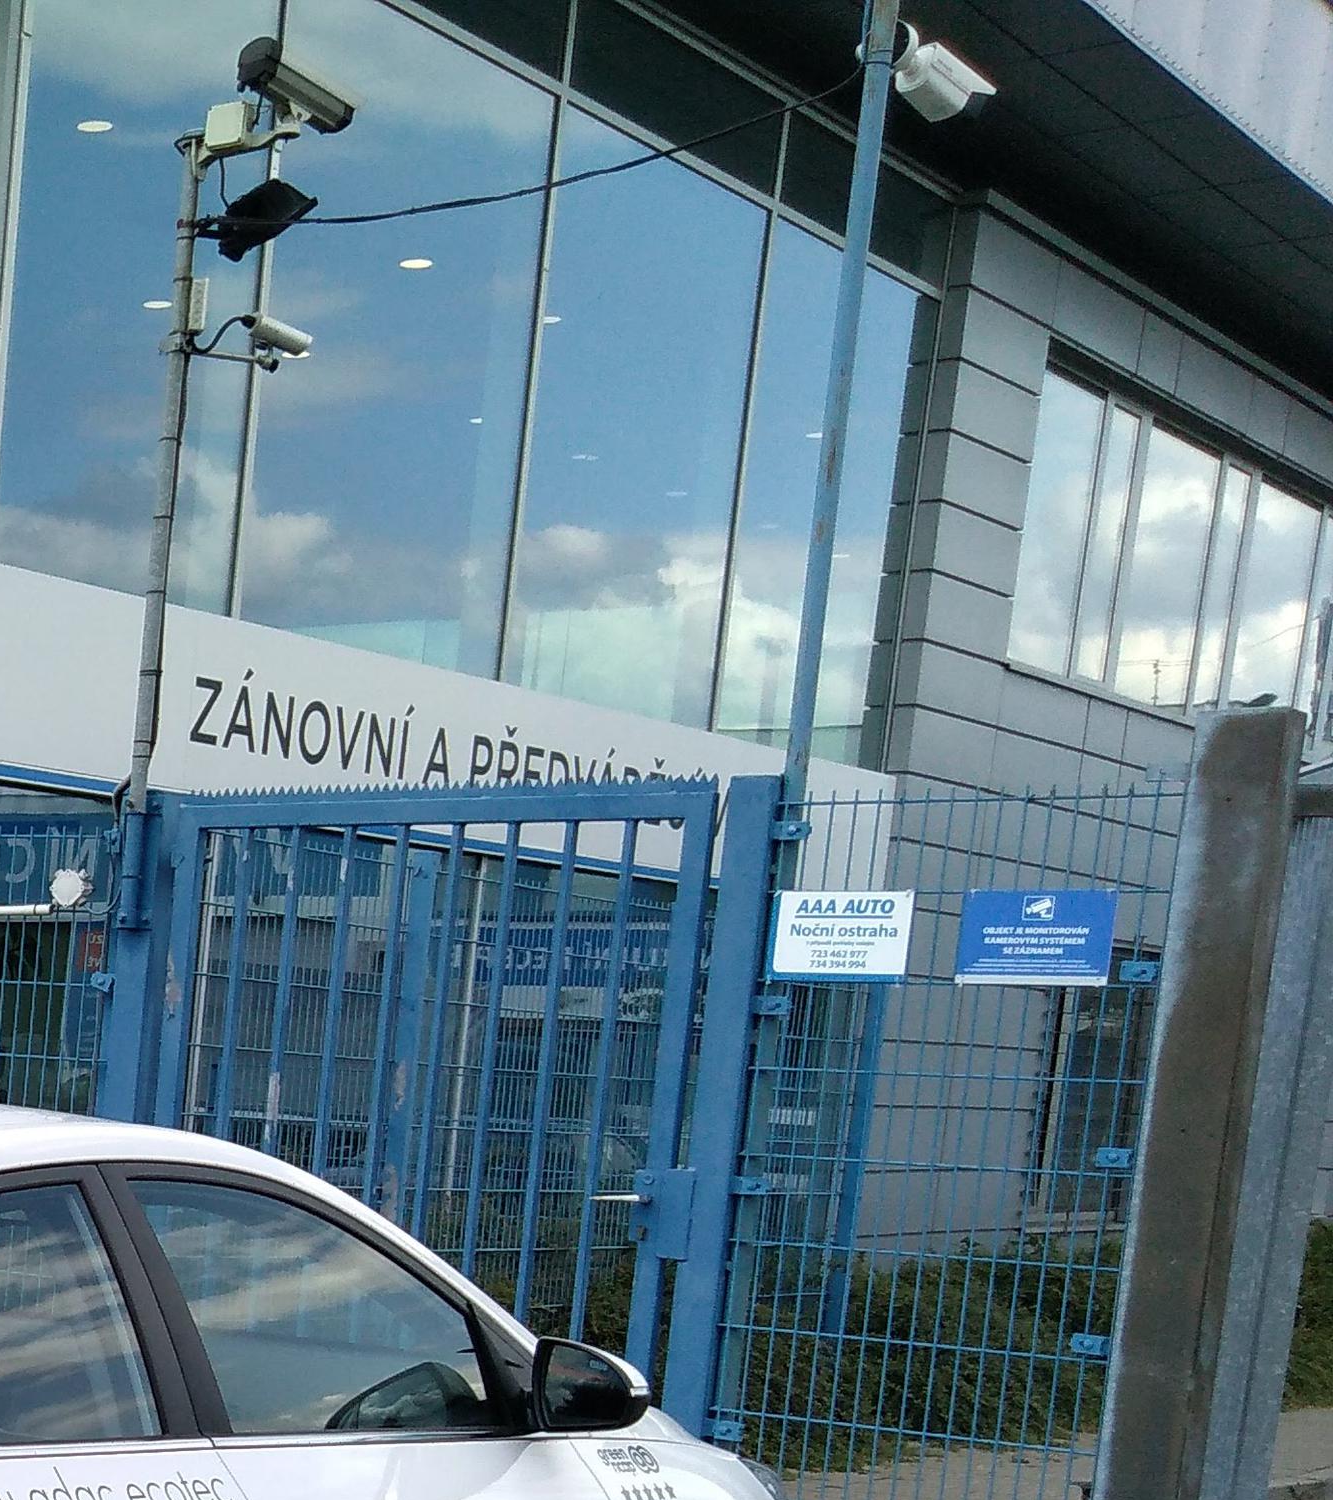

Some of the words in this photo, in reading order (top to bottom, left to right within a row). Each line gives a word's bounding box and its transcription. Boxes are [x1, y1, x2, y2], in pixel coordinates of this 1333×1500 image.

[189, 668, 415, 780] ZÁNOVNÍ
[422, 726, 451, 784] A
[796, 899, 836, 914] AAA
[841, 898, 896, 915] AUTO
[789, 923, 836, 938] Noční
[837, 923, 899, 938] ostraha
